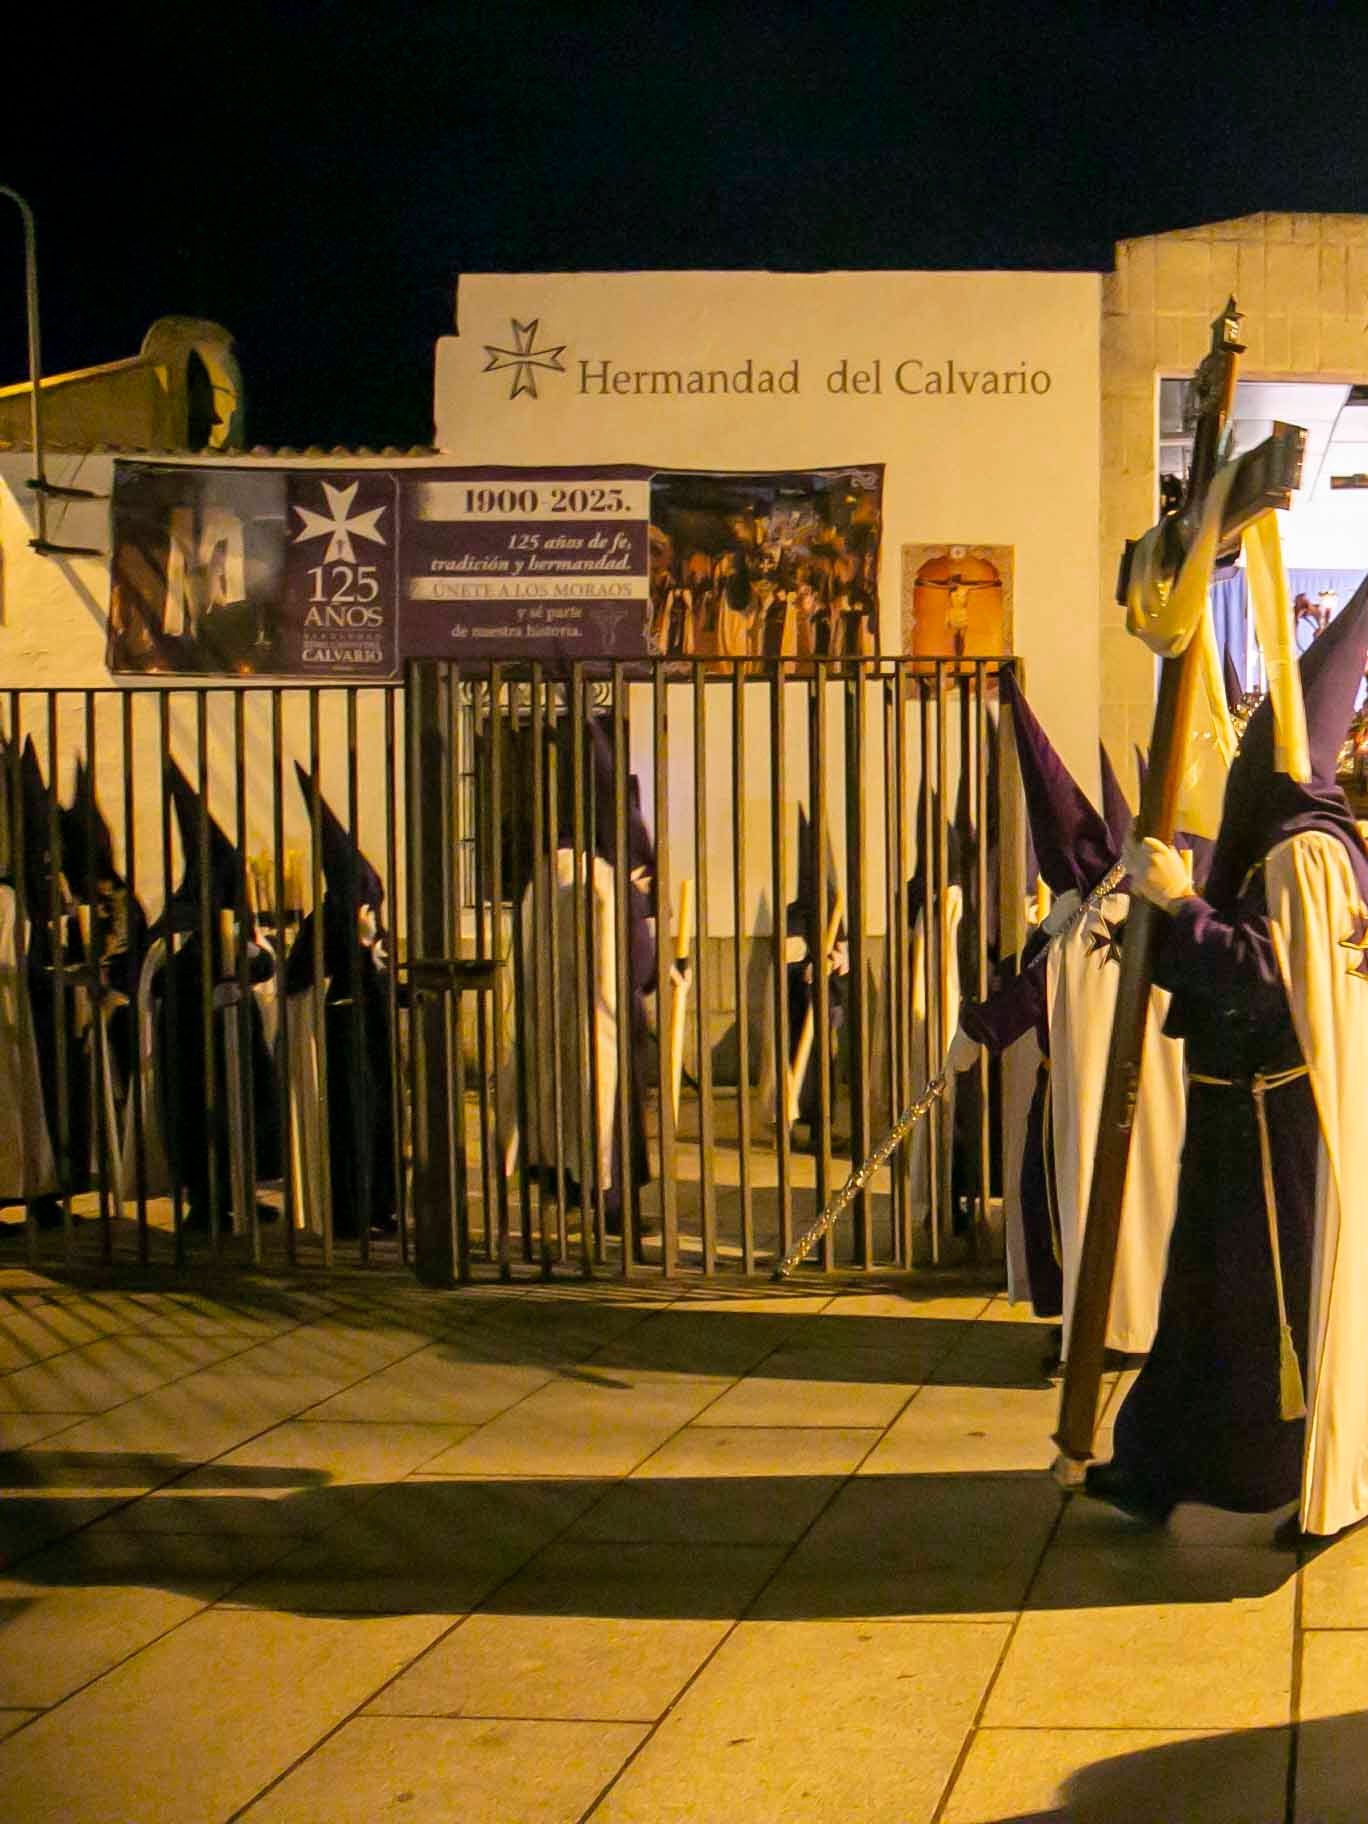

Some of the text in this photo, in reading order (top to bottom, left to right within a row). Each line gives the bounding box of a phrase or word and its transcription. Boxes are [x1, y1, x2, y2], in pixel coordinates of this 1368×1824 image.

[578, 358, 1052, 396] Hermandad del Calvario
[508, 533, 541, 550] 125
[543, 535, 582, 550] años
[587, 532, 608, 549] de
[431, 554, 509, 571] tradición
[511, 559, 525, 576] y
[306, 565, 379, 602] 125
[303, 601, 384, 627] AÑOS
[451, 624, 468, 637] de
[302, 648, 383, 662] CALVARIO
